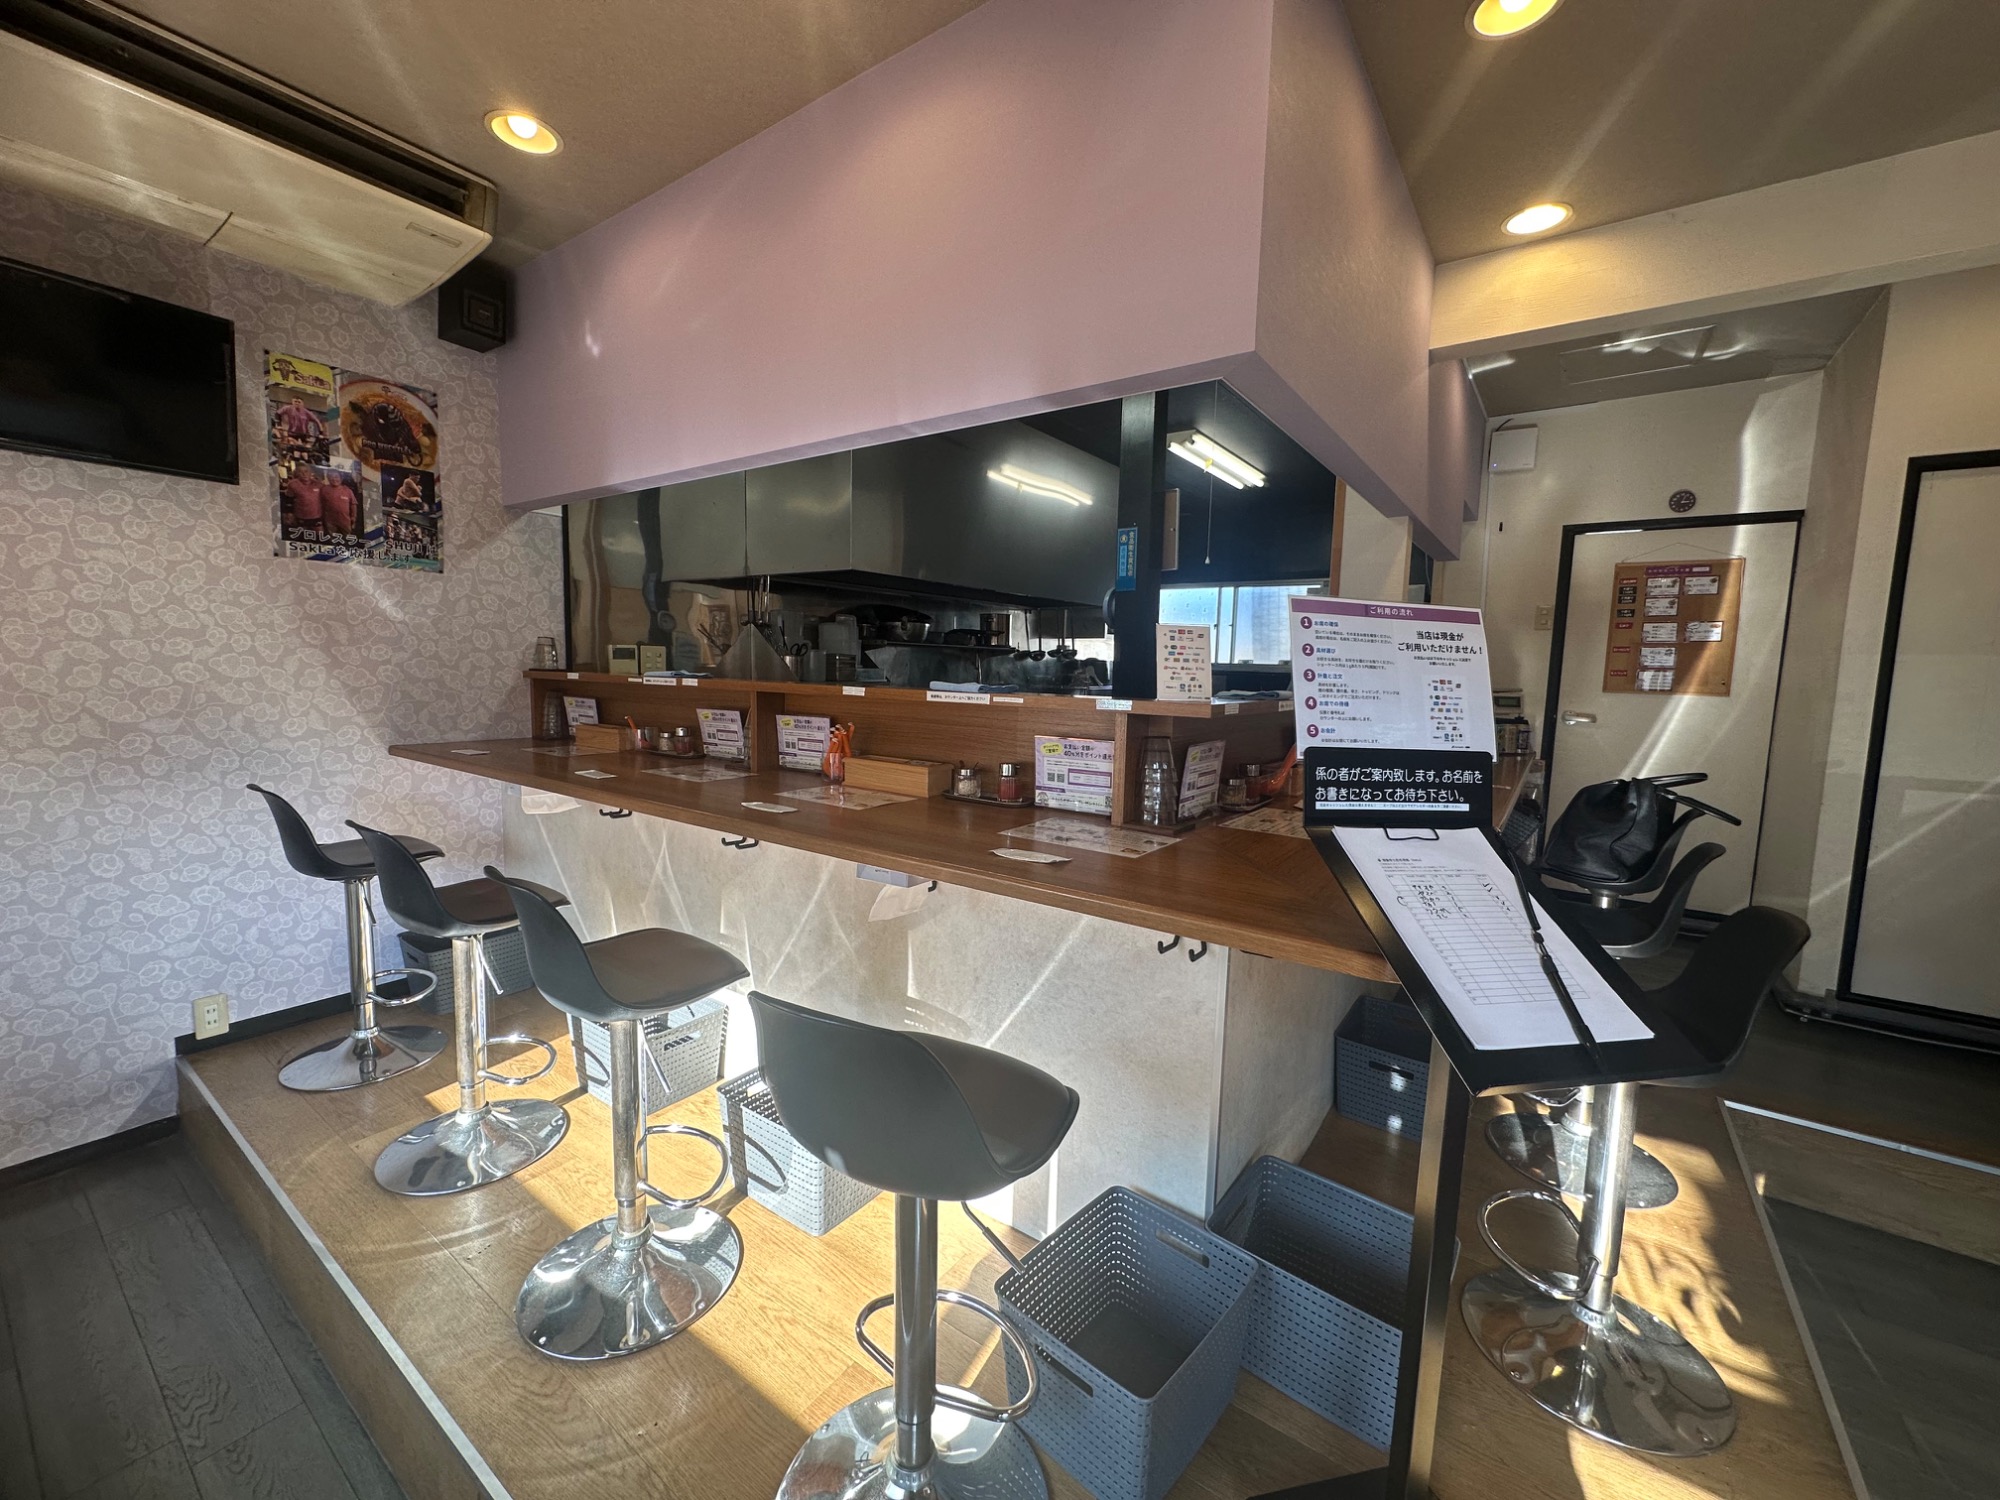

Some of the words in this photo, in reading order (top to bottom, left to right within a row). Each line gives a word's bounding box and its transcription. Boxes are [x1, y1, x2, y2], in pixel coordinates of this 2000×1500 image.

[288, 527, 372, 546] プロレスラー
[1370, 607, 1414, 617] ご利用の流れ
[1416, 630, 1464, 641] 当店は現金が
[1315, 786, 1465, 802] お書きになってお待ち下さい。
